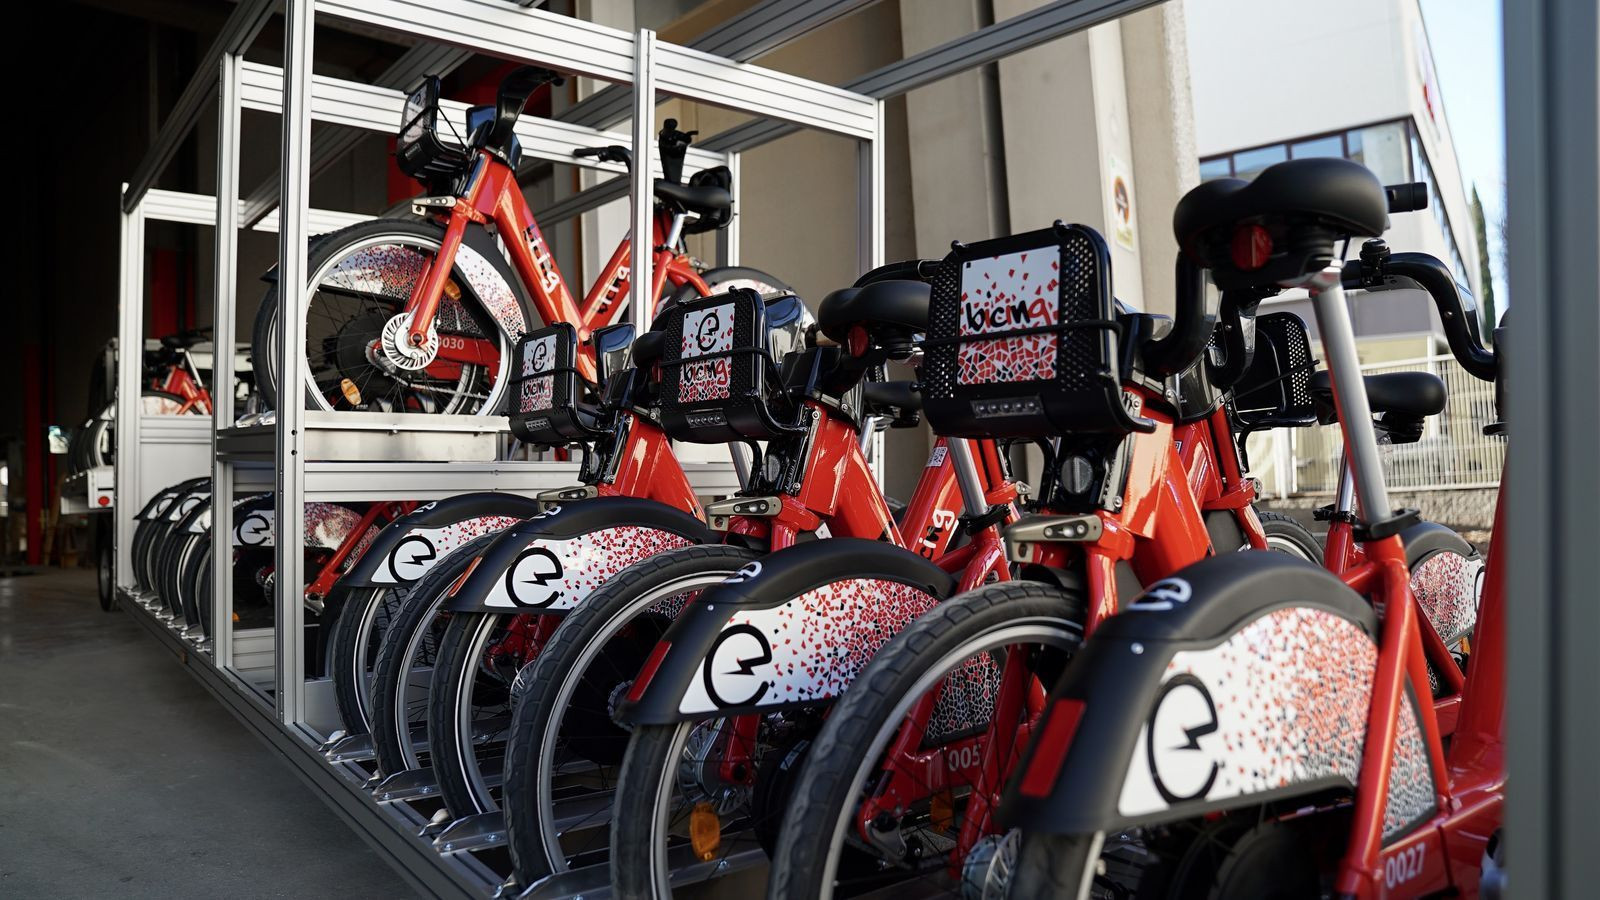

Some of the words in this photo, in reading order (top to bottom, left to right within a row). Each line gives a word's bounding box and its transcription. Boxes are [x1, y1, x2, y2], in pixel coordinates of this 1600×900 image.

[965, 298, 1052, 331] bicing
[683, 359, 728, 386] bicing
[919, 509, 955, 560] cing
[1385, 841, 1426, 889] 0027
